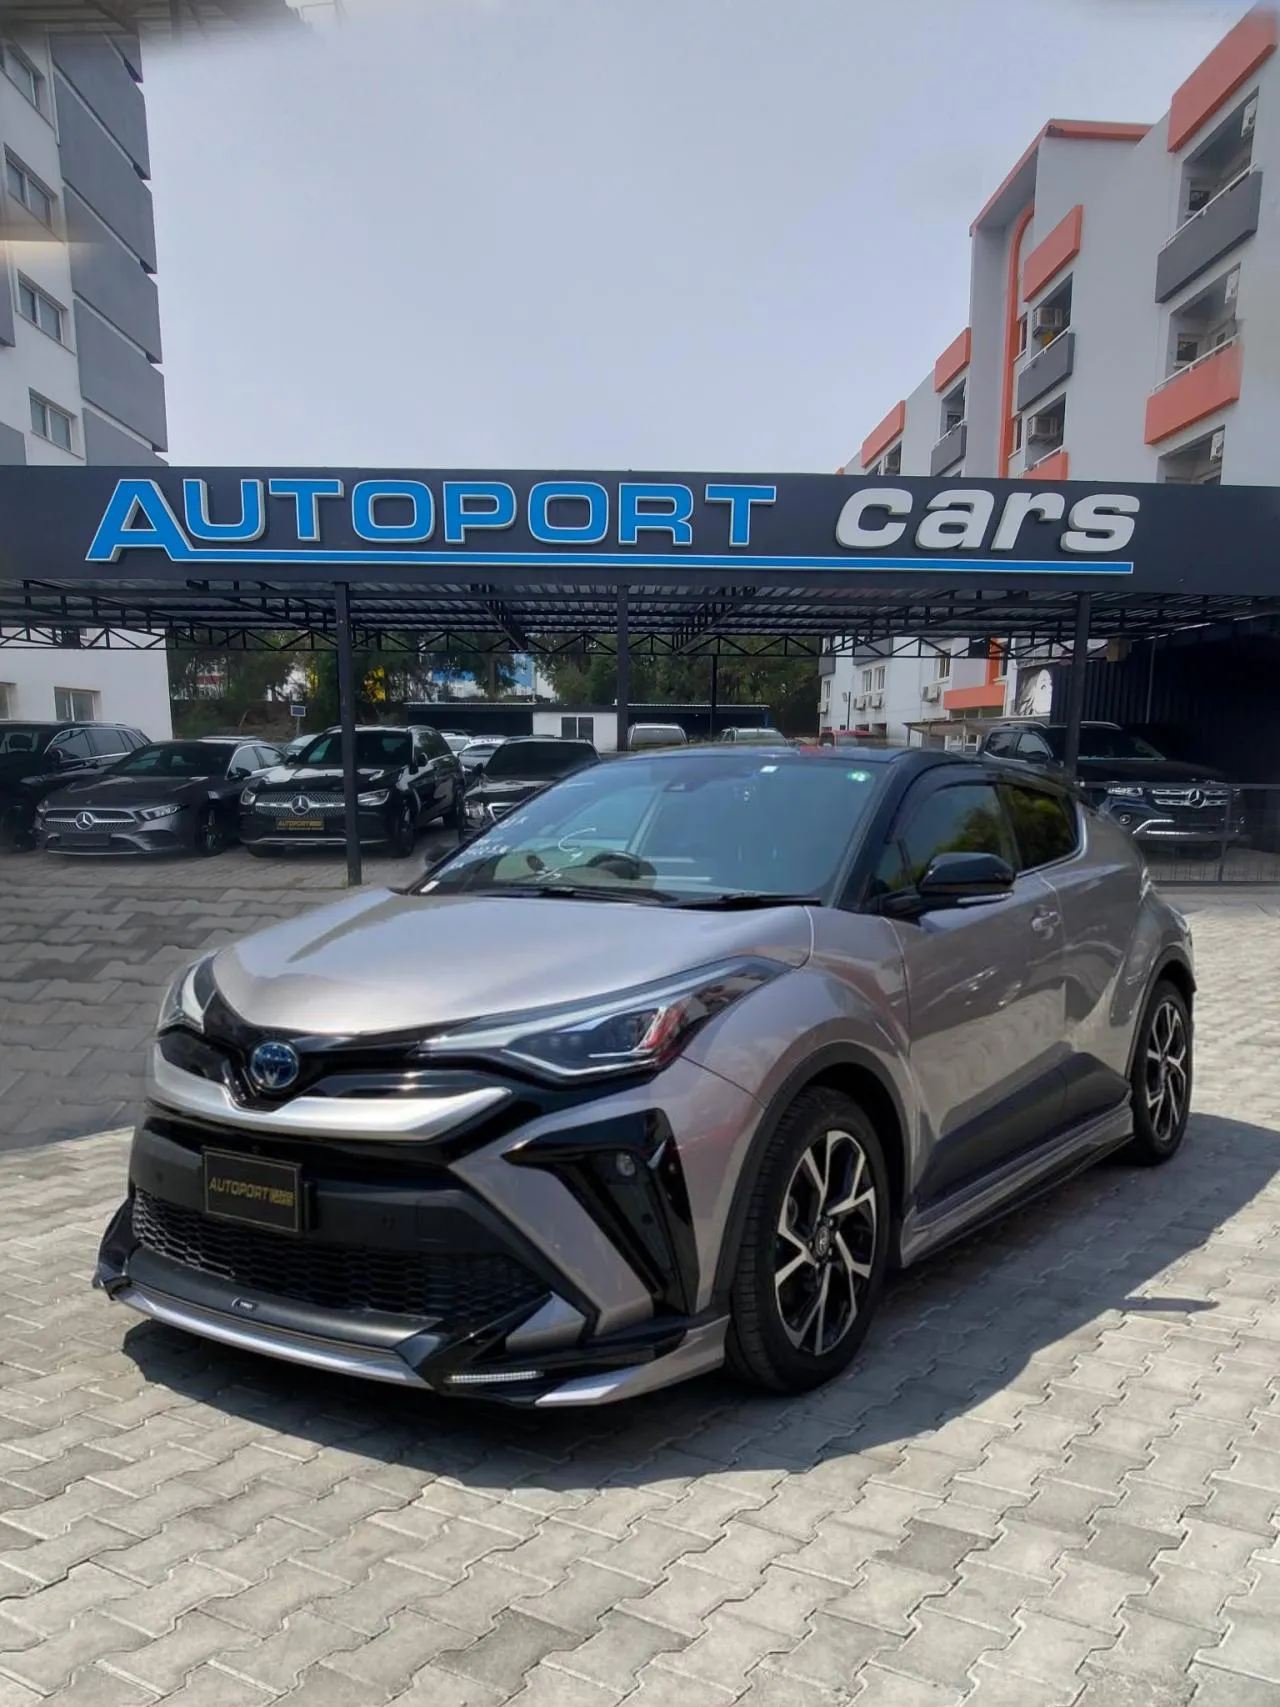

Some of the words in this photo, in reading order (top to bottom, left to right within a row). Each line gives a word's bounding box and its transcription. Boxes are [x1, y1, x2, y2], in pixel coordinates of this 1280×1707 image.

[85, 478, 777, 562] AUTOPORT
[835, 487, 1141, 553] cars
[209, 1177, 269, 1200] AUTOPORT
